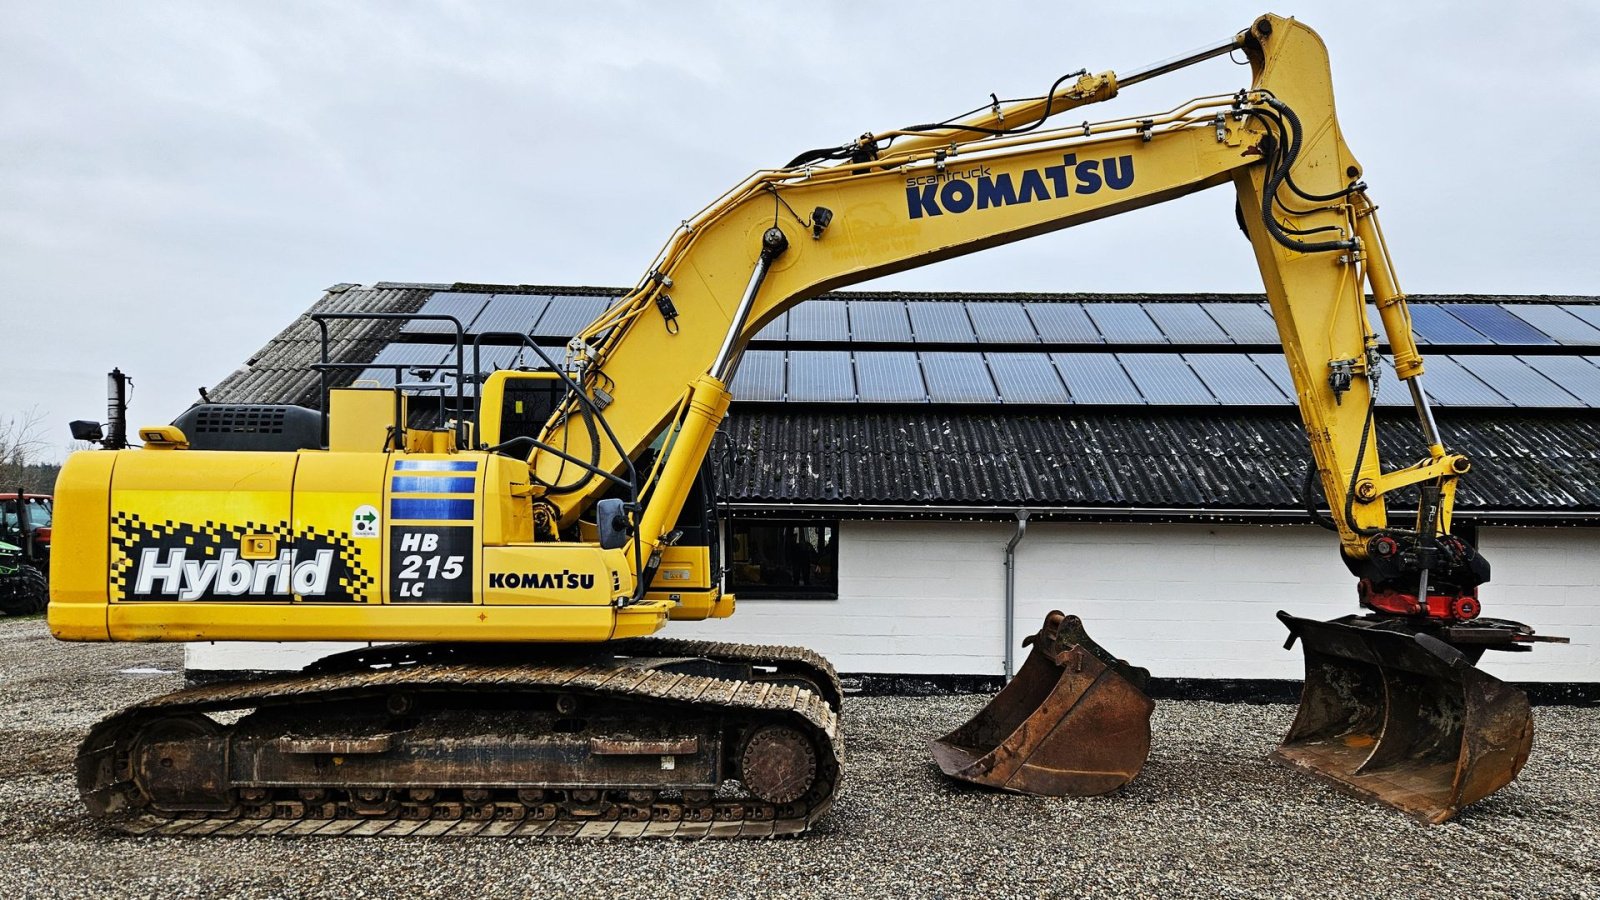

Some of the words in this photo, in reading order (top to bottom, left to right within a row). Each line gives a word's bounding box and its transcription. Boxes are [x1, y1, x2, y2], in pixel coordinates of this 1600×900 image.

[905, 153, 1135, 219] KOMATSU
[906, 165, 992, 187] scantruck
[400, 533, 439, 552] HB
[134, 547, 334, 601] Hybrid
[398, 555, 465, 580] 215
[400, 582, 425, 597] LC
[489, 569, 594, 589] KOMATSU
